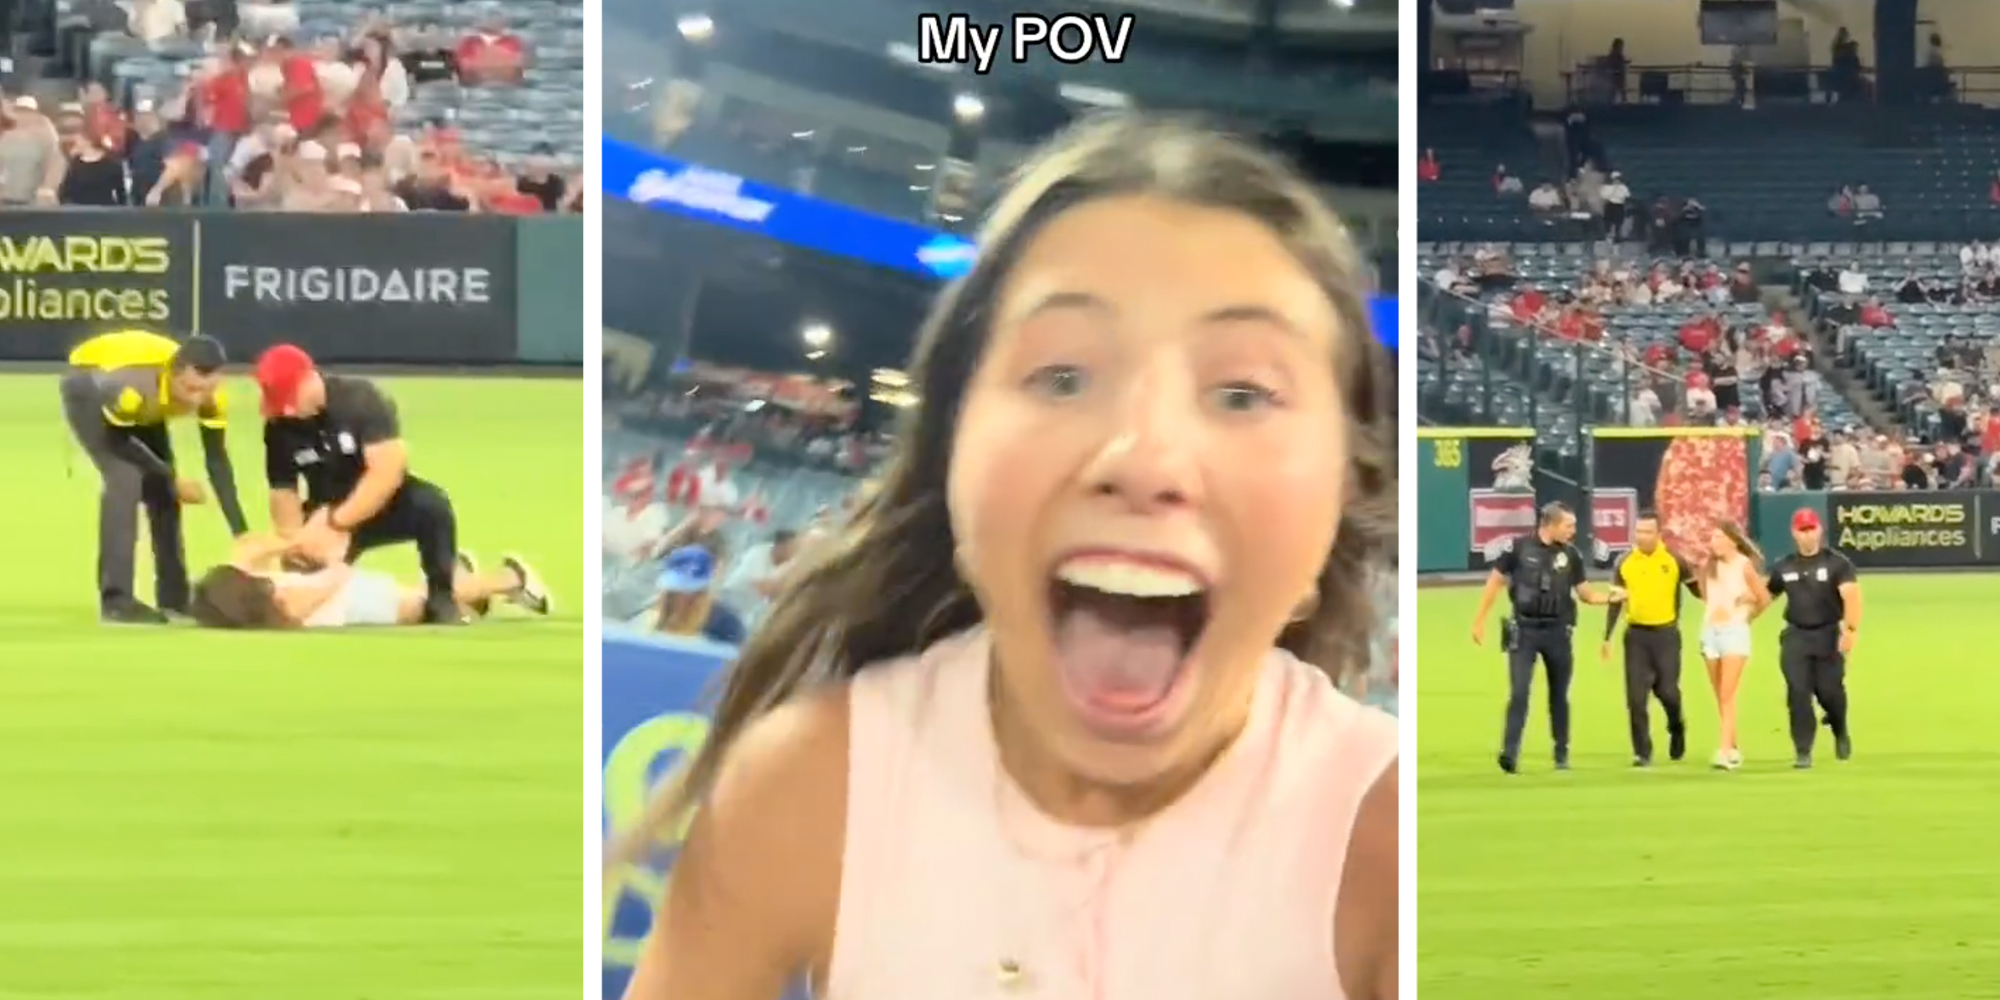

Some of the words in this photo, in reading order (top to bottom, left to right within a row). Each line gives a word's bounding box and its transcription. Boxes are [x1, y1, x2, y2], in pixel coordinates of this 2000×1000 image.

[224, 265, 490, 303] FRIGIDAIRE
[1837, 504, 1965, 524] HOWARDS
[1838, 526, 1966, 550] Appliances
